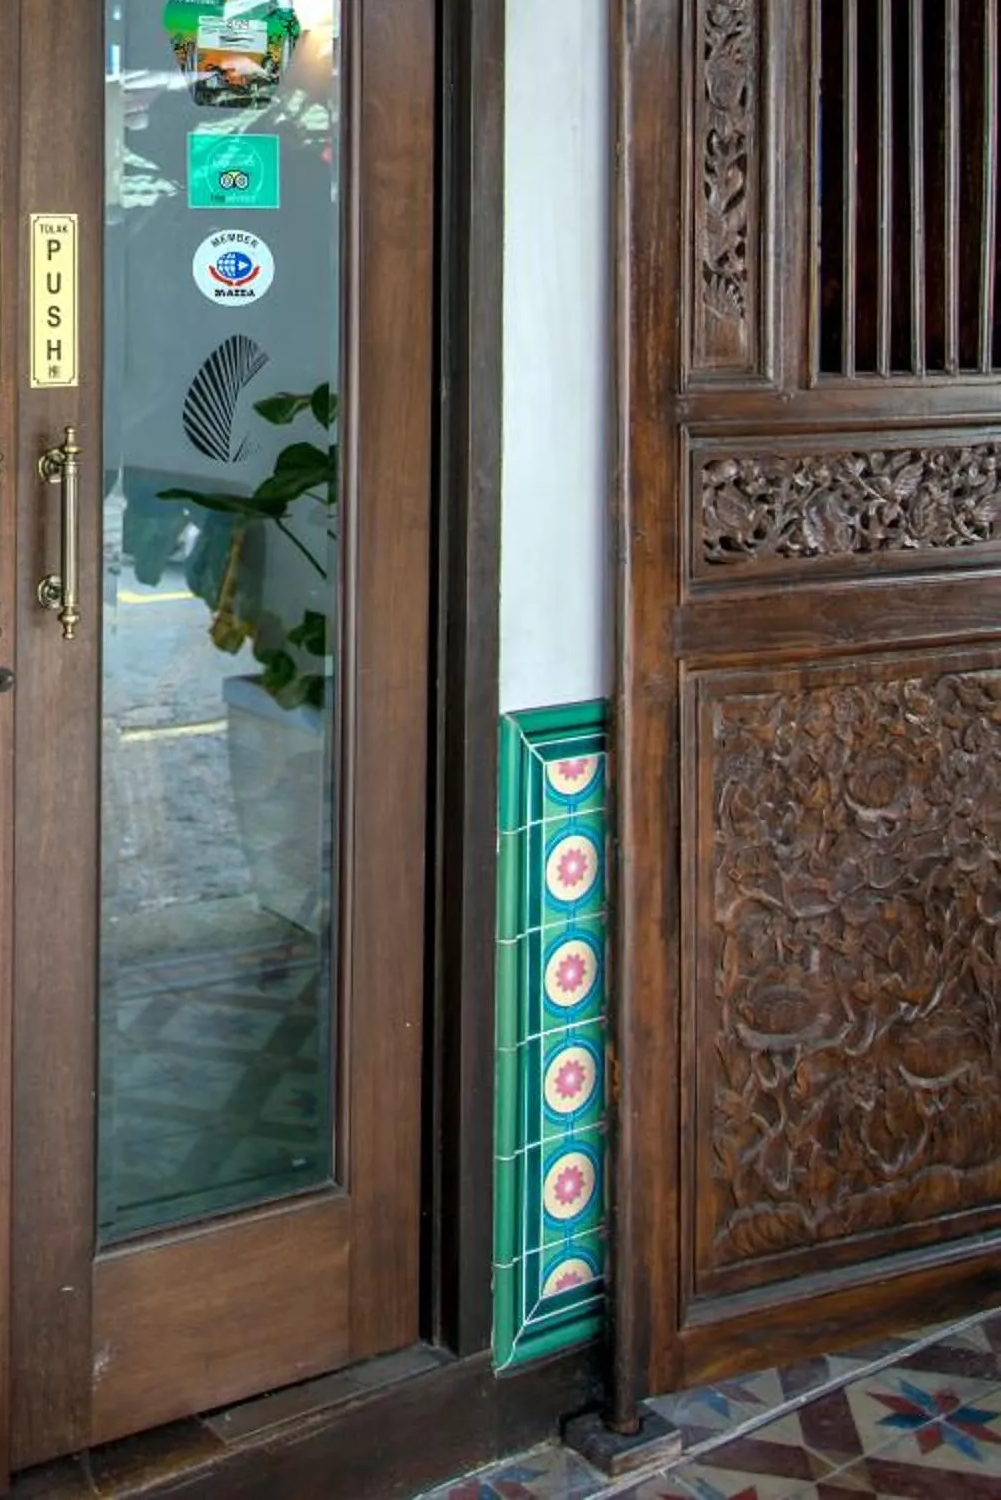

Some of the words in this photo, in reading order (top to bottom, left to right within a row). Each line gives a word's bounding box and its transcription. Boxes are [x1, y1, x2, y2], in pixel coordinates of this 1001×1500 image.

[40, 224, 68, 234] TOLAK
[211, 233, 259, 249] MEMBER
[46, 239, 62, 361] PUSH
